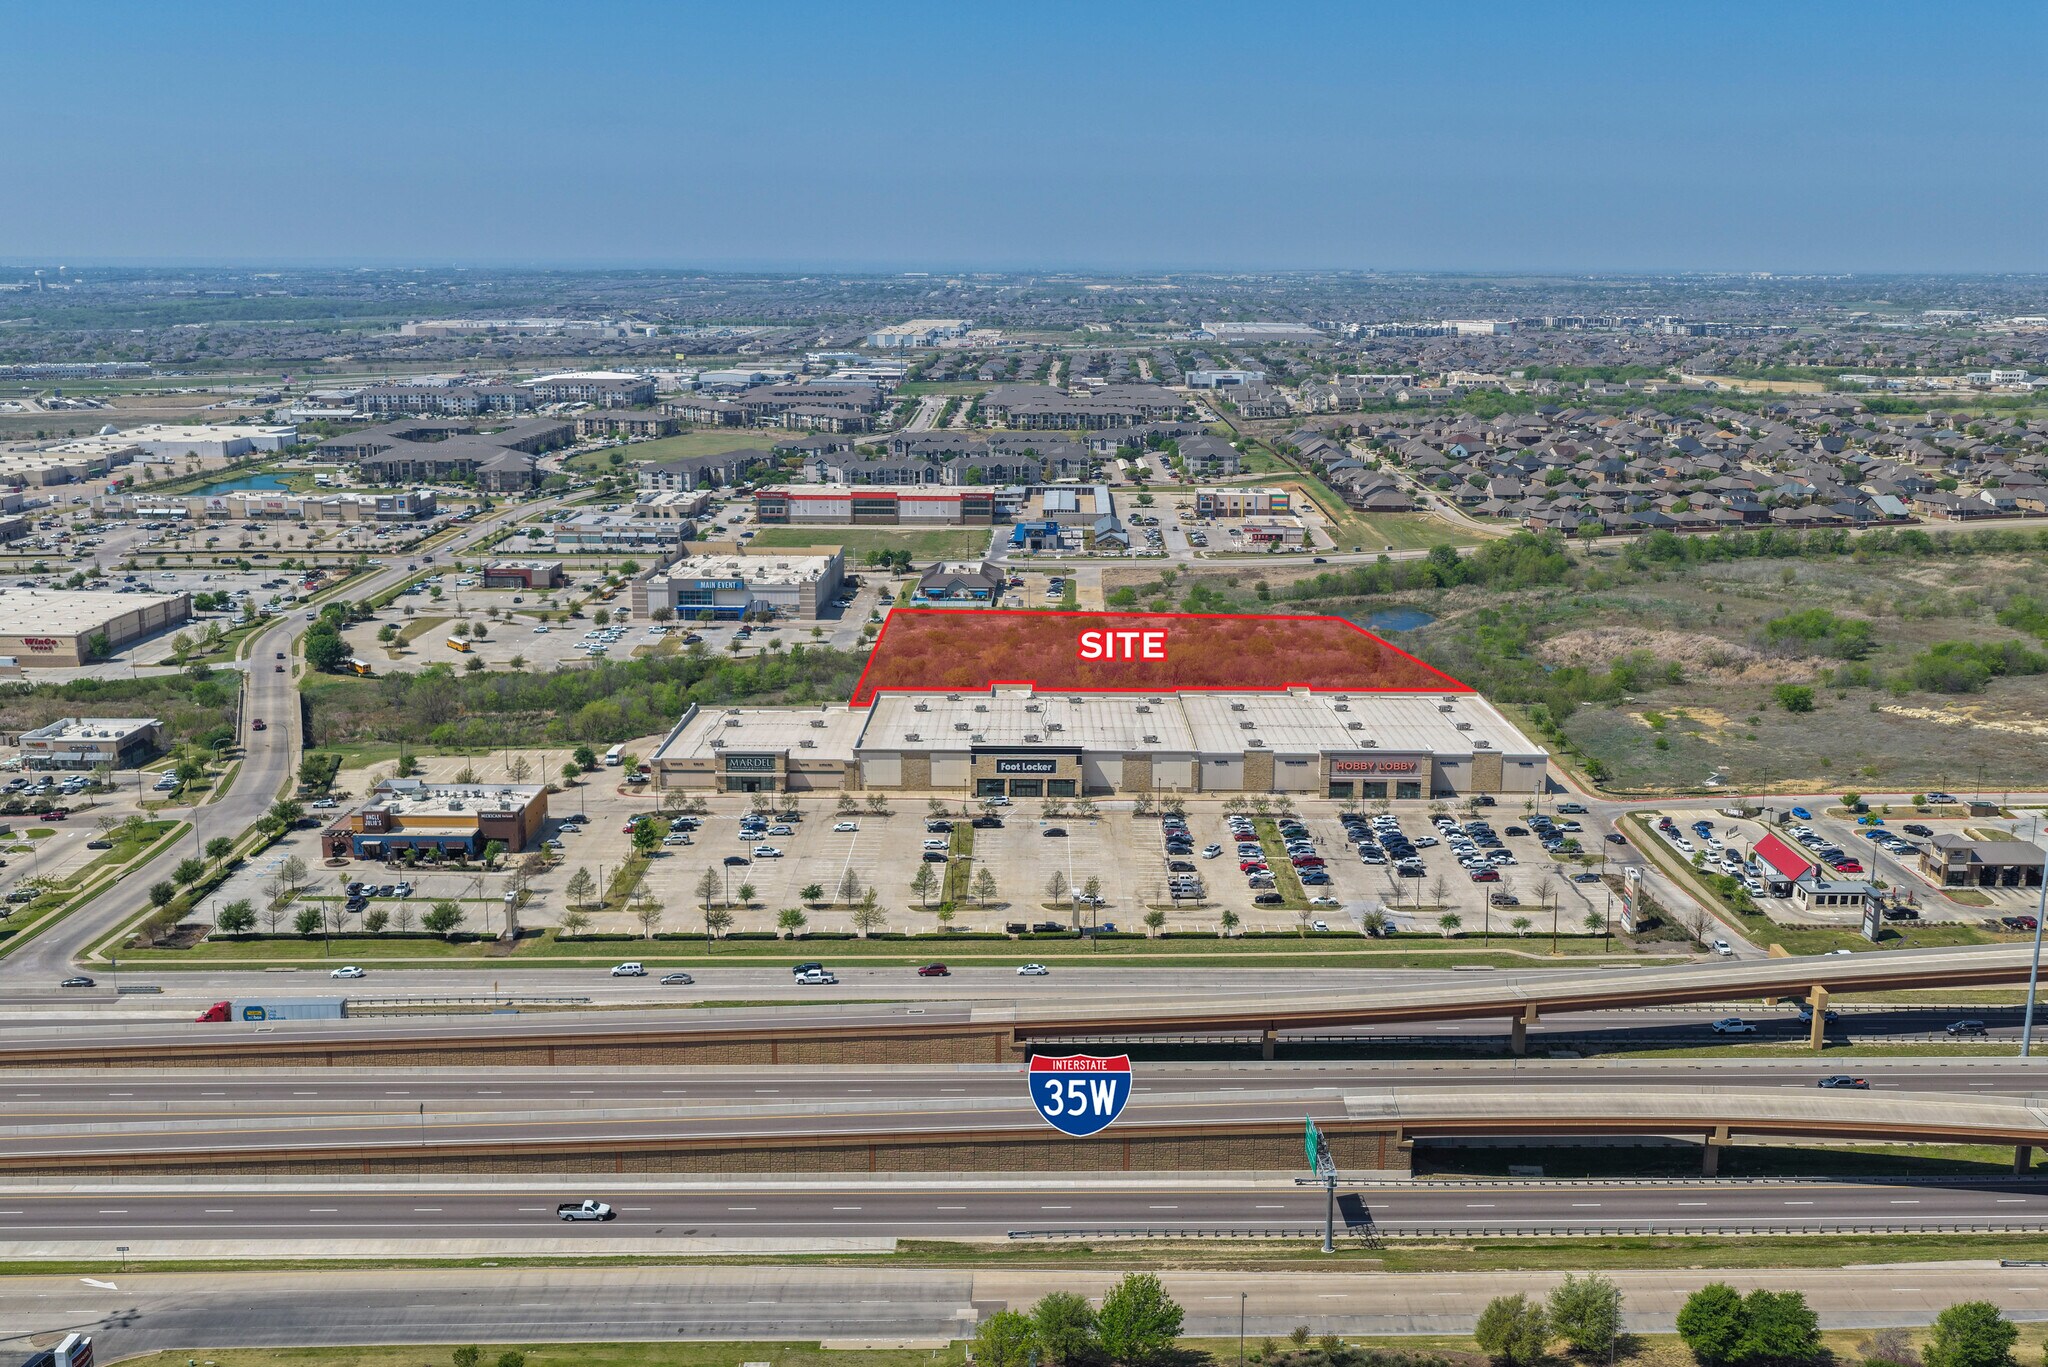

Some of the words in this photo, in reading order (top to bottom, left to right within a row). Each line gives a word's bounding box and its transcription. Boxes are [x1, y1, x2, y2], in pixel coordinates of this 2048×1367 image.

[700, 581, 716, 589] MAIN
[717, 581, 736, 589] EVENT
[730, 758, 772, 767] MARDEL
[1336, 762, 1375, 771] HOBBY
[1378, 762, 1415, 771] LOBBY
[1000, 763, 1021, 771] Foot
[1022, 763, 1052, 771] Locker
